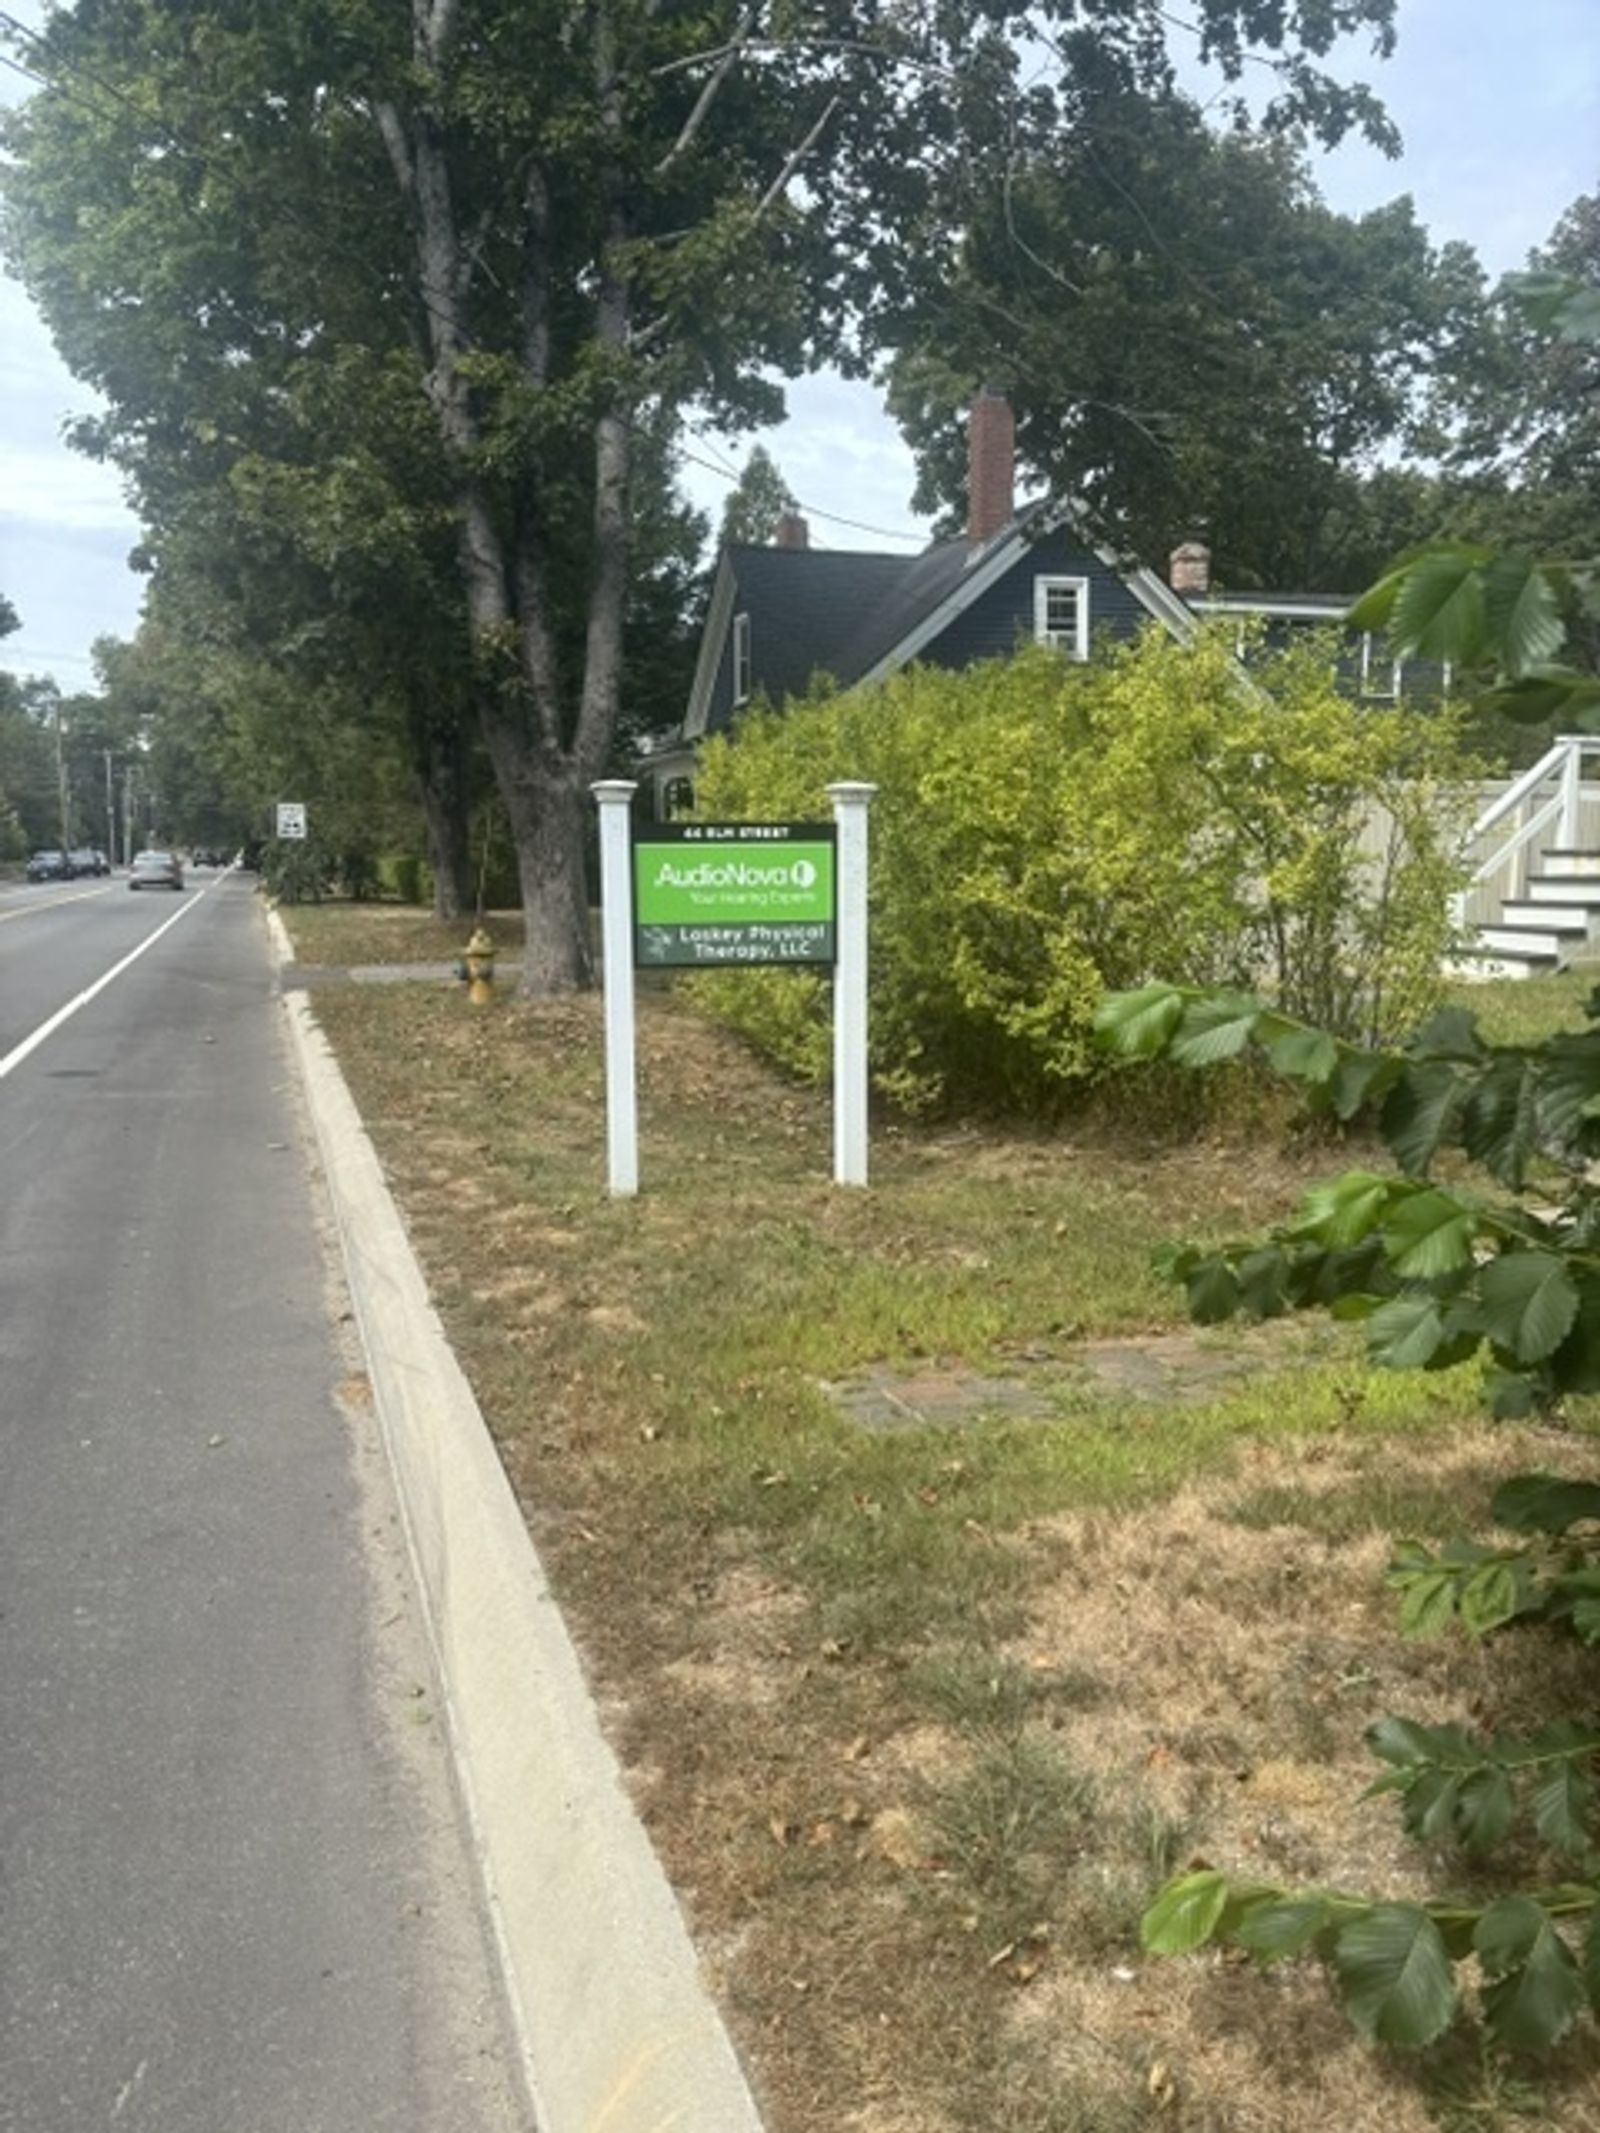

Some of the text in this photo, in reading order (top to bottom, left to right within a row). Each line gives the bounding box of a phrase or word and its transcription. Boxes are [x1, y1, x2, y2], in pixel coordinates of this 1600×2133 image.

[740, 827, 790, 838] STREET
[654, 862, 788, 887] AudioNova
[749, 925, 825, 942] Physical
[780, 941, 811, 956] LLC
